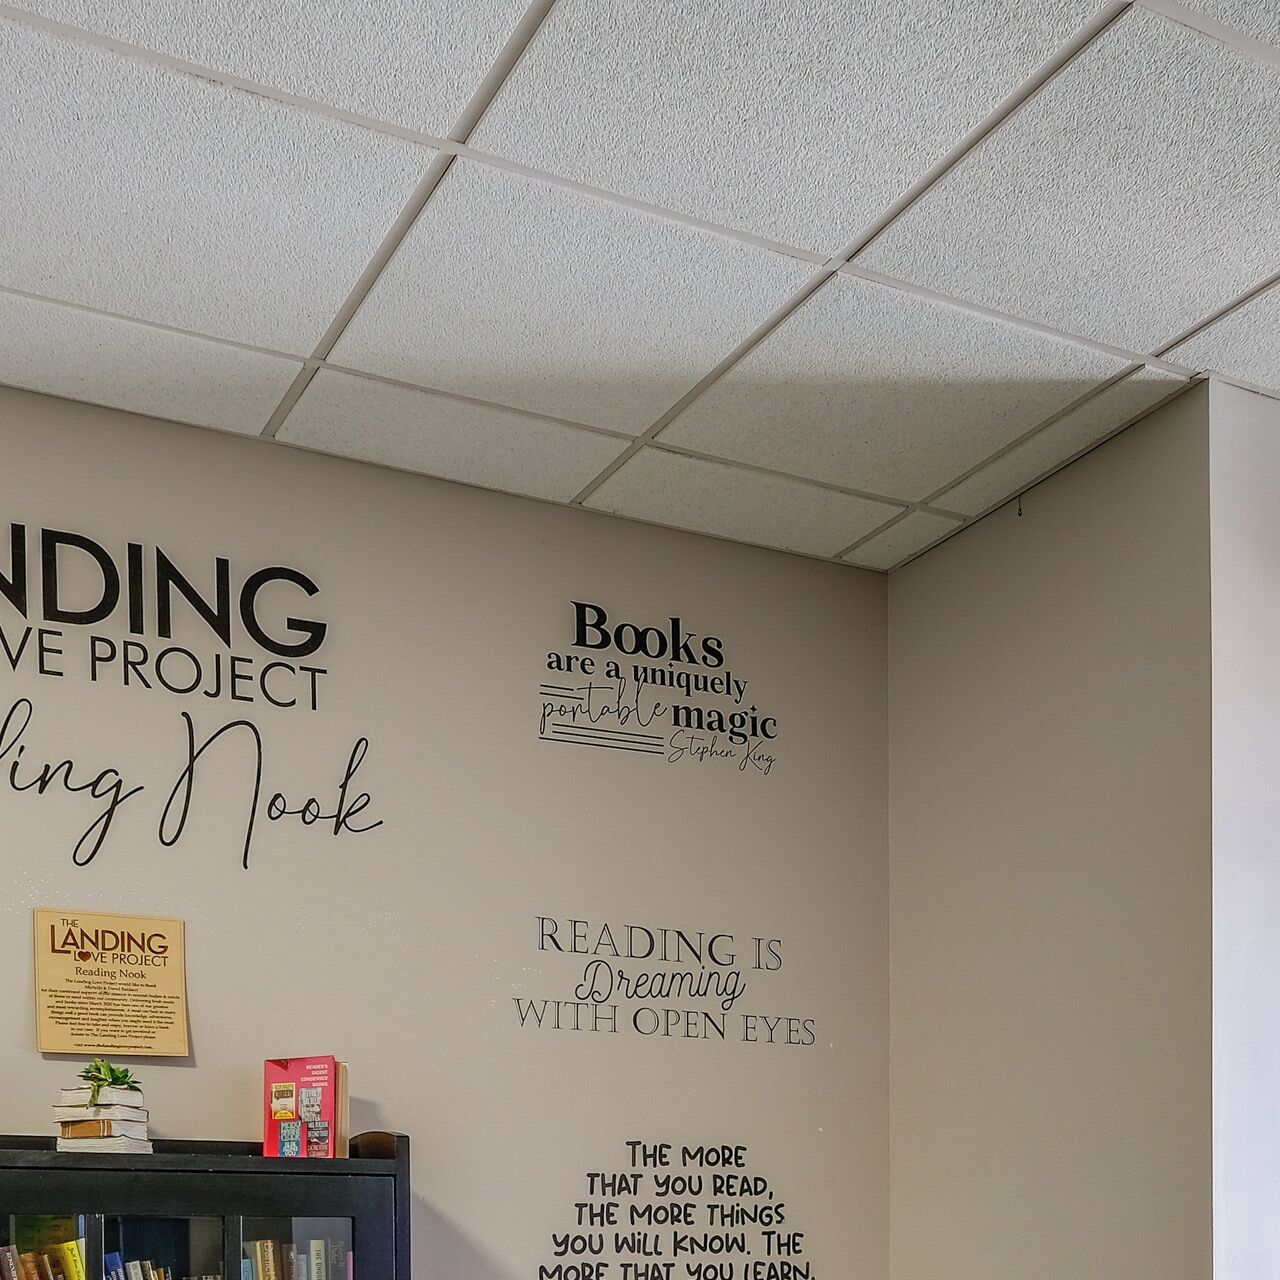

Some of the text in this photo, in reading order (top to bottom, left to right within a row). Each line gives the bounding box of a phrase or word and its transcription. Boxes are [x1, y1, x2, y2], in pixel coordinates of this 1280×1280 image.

[570, 600, 724, 669] Books
[91, 635, 328, 711] PROJECT
[547, 651, 748, 704] are a uniquely
[540, 671, 777, 746] portable magic
[668, 729, 776, 776] Stephen King
[158, 711, 384, 870] Nook
[51, 925, 168, 955] LANDING
[61, 919, 79, 928] THE
[535, 916, 782, 971] READING IS
[75, 966, 146, 980] Reading Nook
[112, 953, 168, 967] PROJECT
[575, 959, 746, 1011] Dreaming
[511, 997, 816, 1046] WITH OPEN EYES
[625, 1140, 748, 1169] THE MORE
[585, 1172, 774, 1201] THAT YOU READ,
[574, 1201, 620, 1228] THE
[629, 1202, 697, 1226] MORE
[264, 1242, 275, 1275] Daniel
[551, 1233, 604, 1257] YOU
[672, 1230, 752, 1258] KNOW.
[760, 1230, 805, 1257] THE
